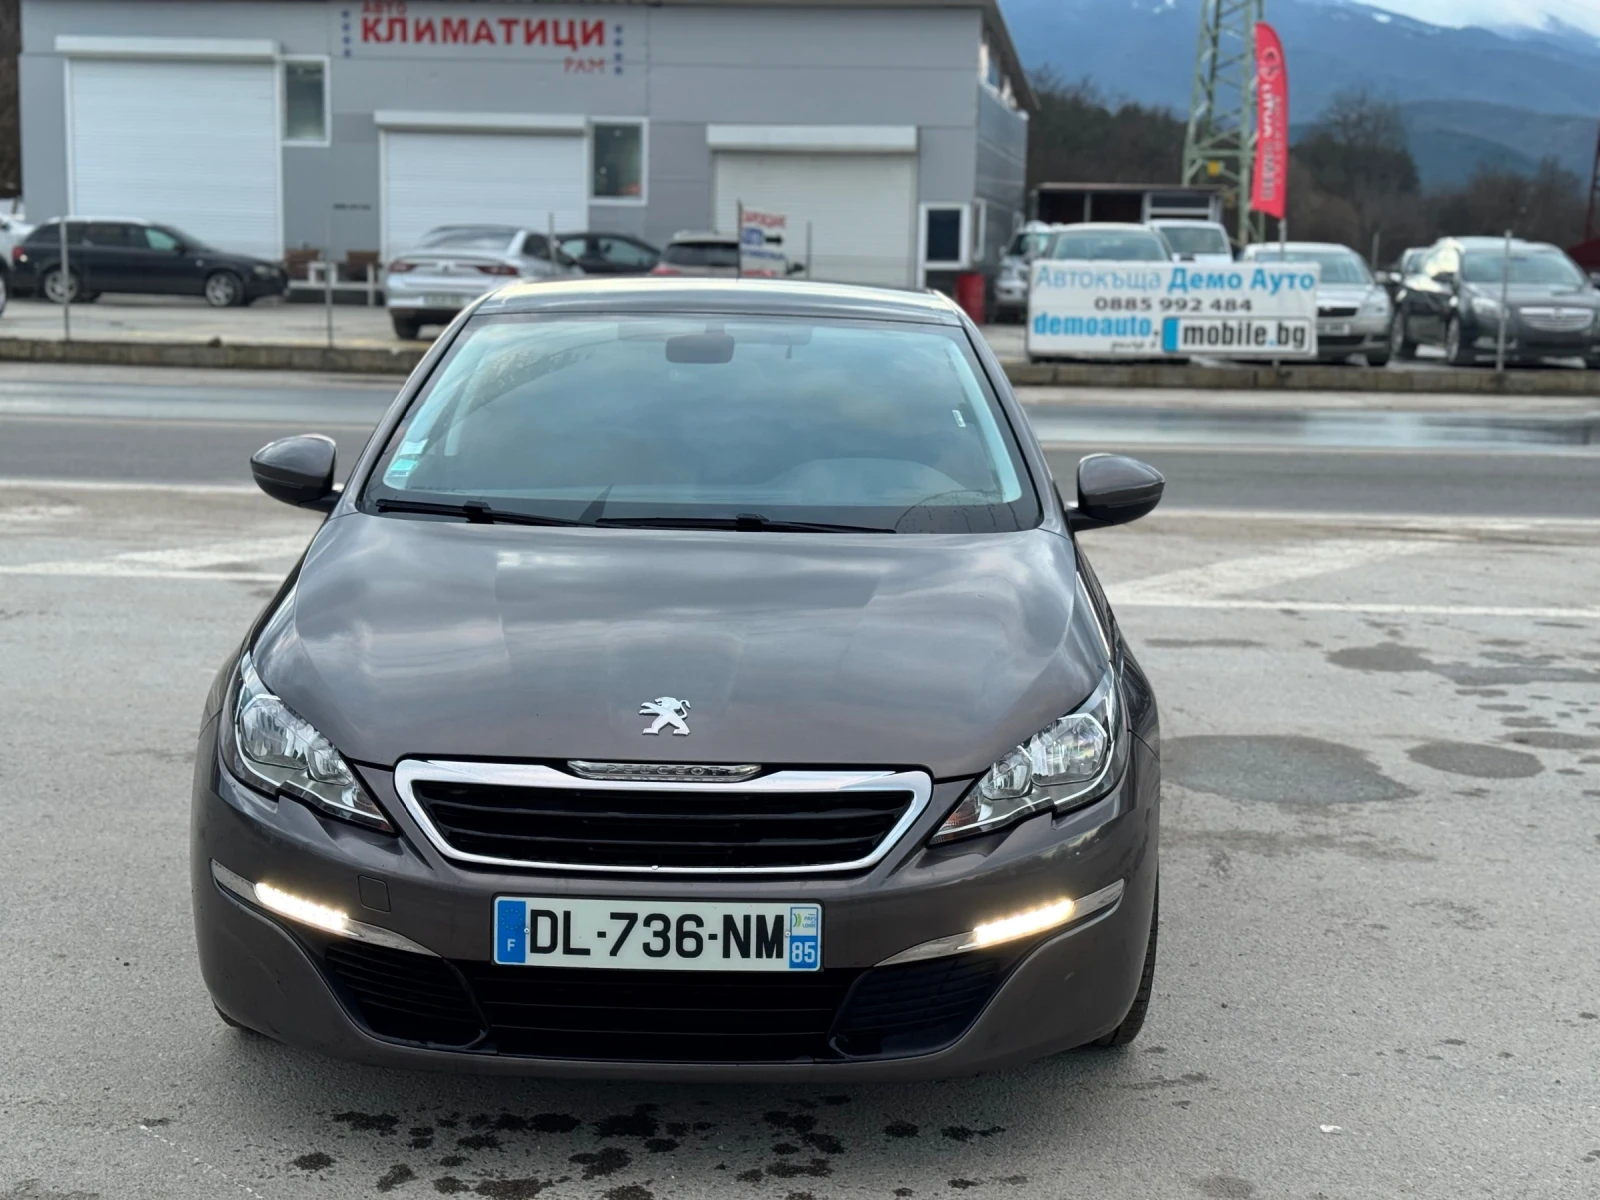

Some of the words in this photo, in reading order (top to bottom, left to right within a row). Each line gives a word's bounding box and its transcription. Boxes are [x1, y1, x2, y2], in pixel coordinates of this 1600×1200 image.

[361, 17, 606, 51] КЛИМАТИЦИ
[1034, 266, 1161, 290] Автокъща
[1167, 267, 1243, 293] Демо
[1249, 268, 1316, 295] Ауто
[1094, 298, 1153, 313] 0885
[1159, 298, 1203, 313] 992
[1209, 298, 1254, 313] 484
[1182, 320, 1306, 349] mobile.bg
[507, 938, 516, 952] F
[529, 908, 785, 959] DL-736-NM
[791, 941, 816, 963] 85
